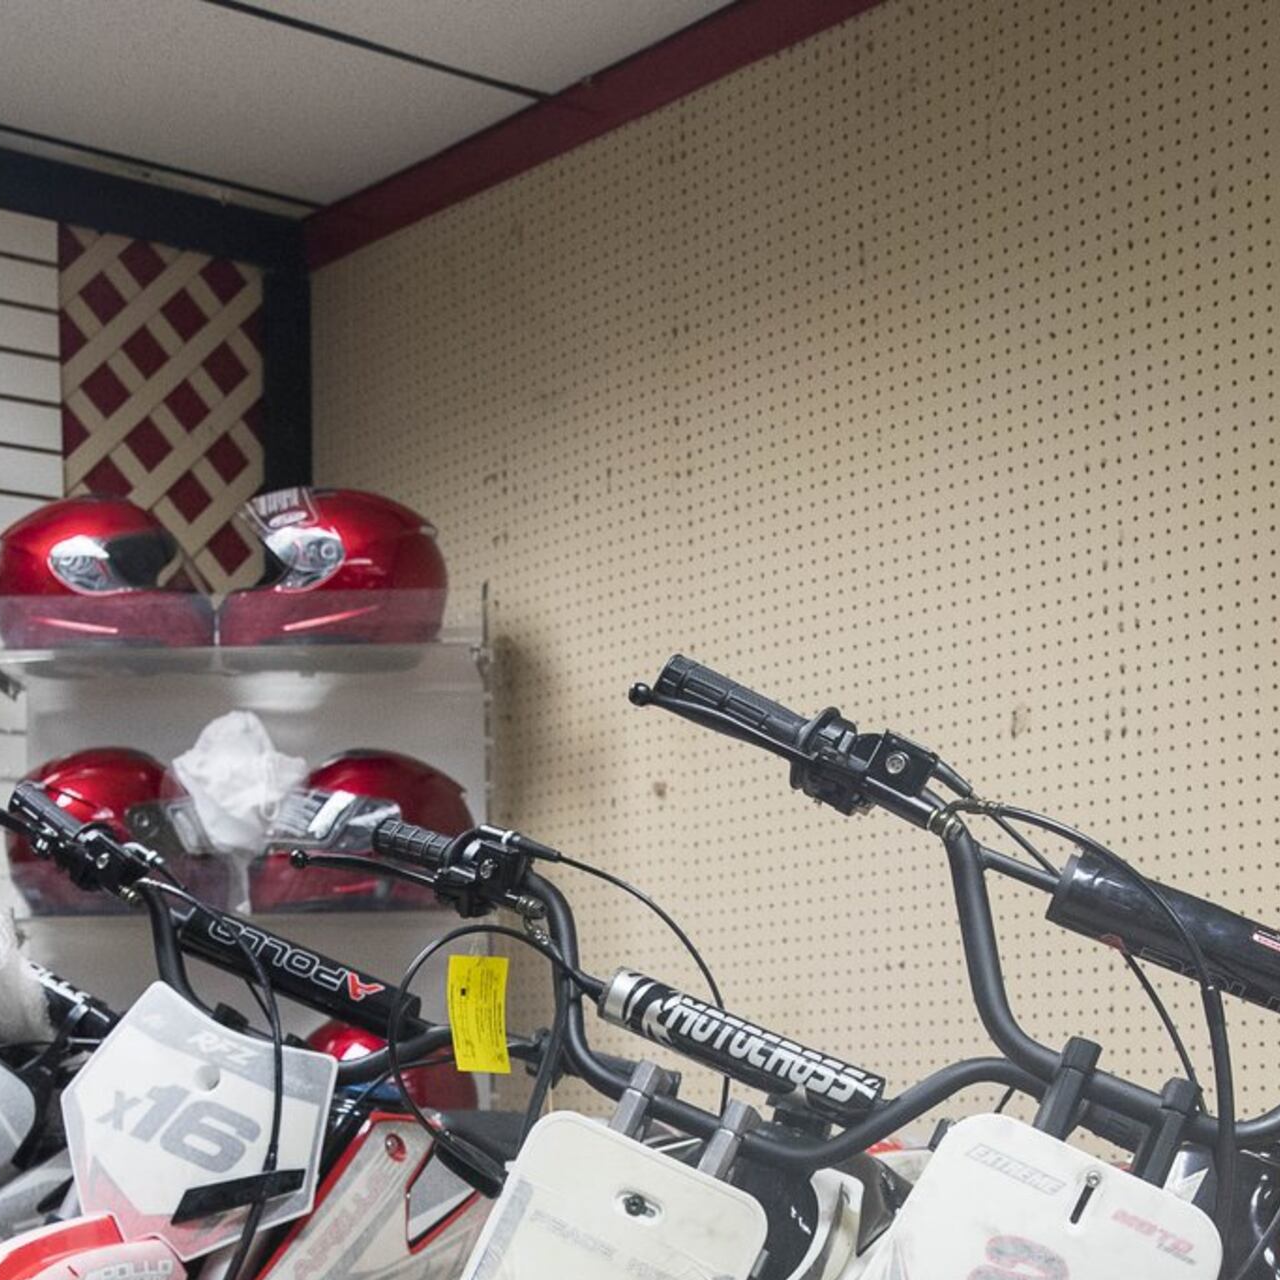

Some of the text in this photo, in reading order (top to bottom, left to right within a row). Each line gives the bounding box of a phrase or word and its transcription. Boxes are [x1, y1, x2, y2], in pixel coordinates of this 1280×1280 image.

[208, 915, 386, 1002] APOLLO
[664, 995, 867, 1103] MOTOCROSS
[965, 1143, 1068, 1197] EXTREME
